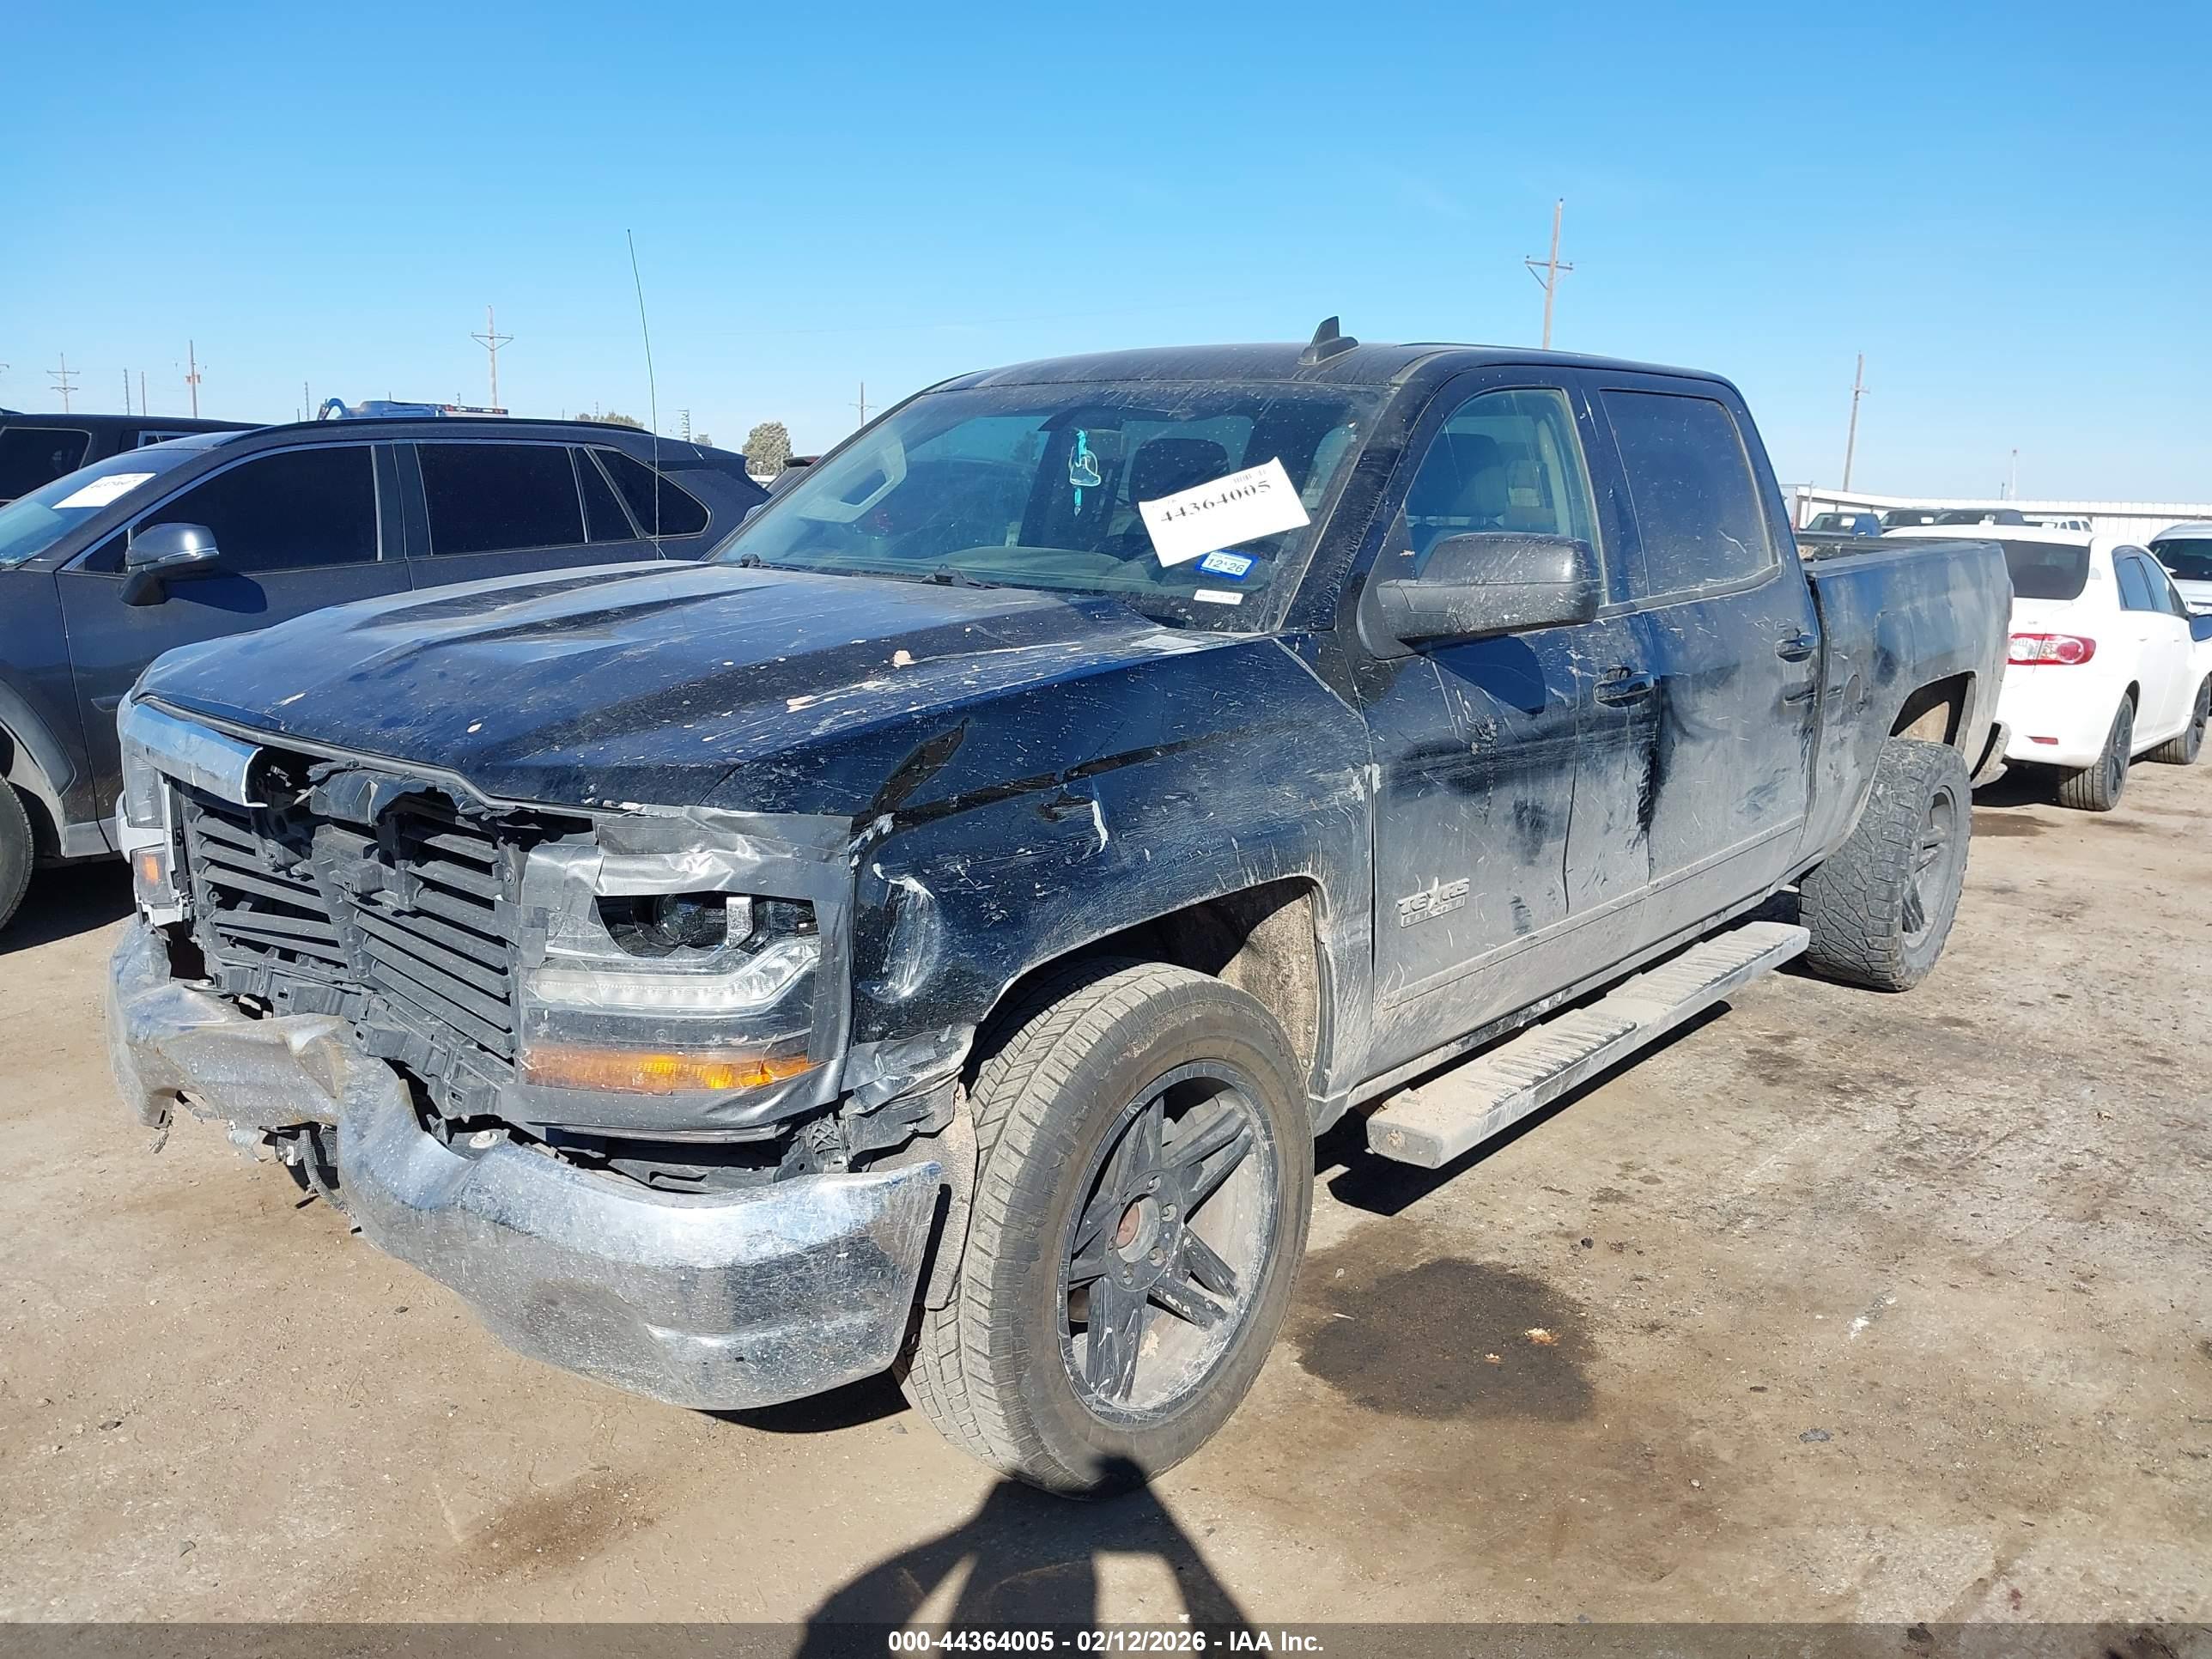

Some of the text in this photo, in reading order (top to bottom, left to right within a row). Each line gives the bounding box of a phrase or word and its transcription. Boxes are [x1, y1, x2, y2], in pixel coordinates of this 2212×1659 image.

[1160, 479, 1272, 522] 44364005
[1207, 558, 1224, 568] 12
[1227, 562, 1245, 573] 26
